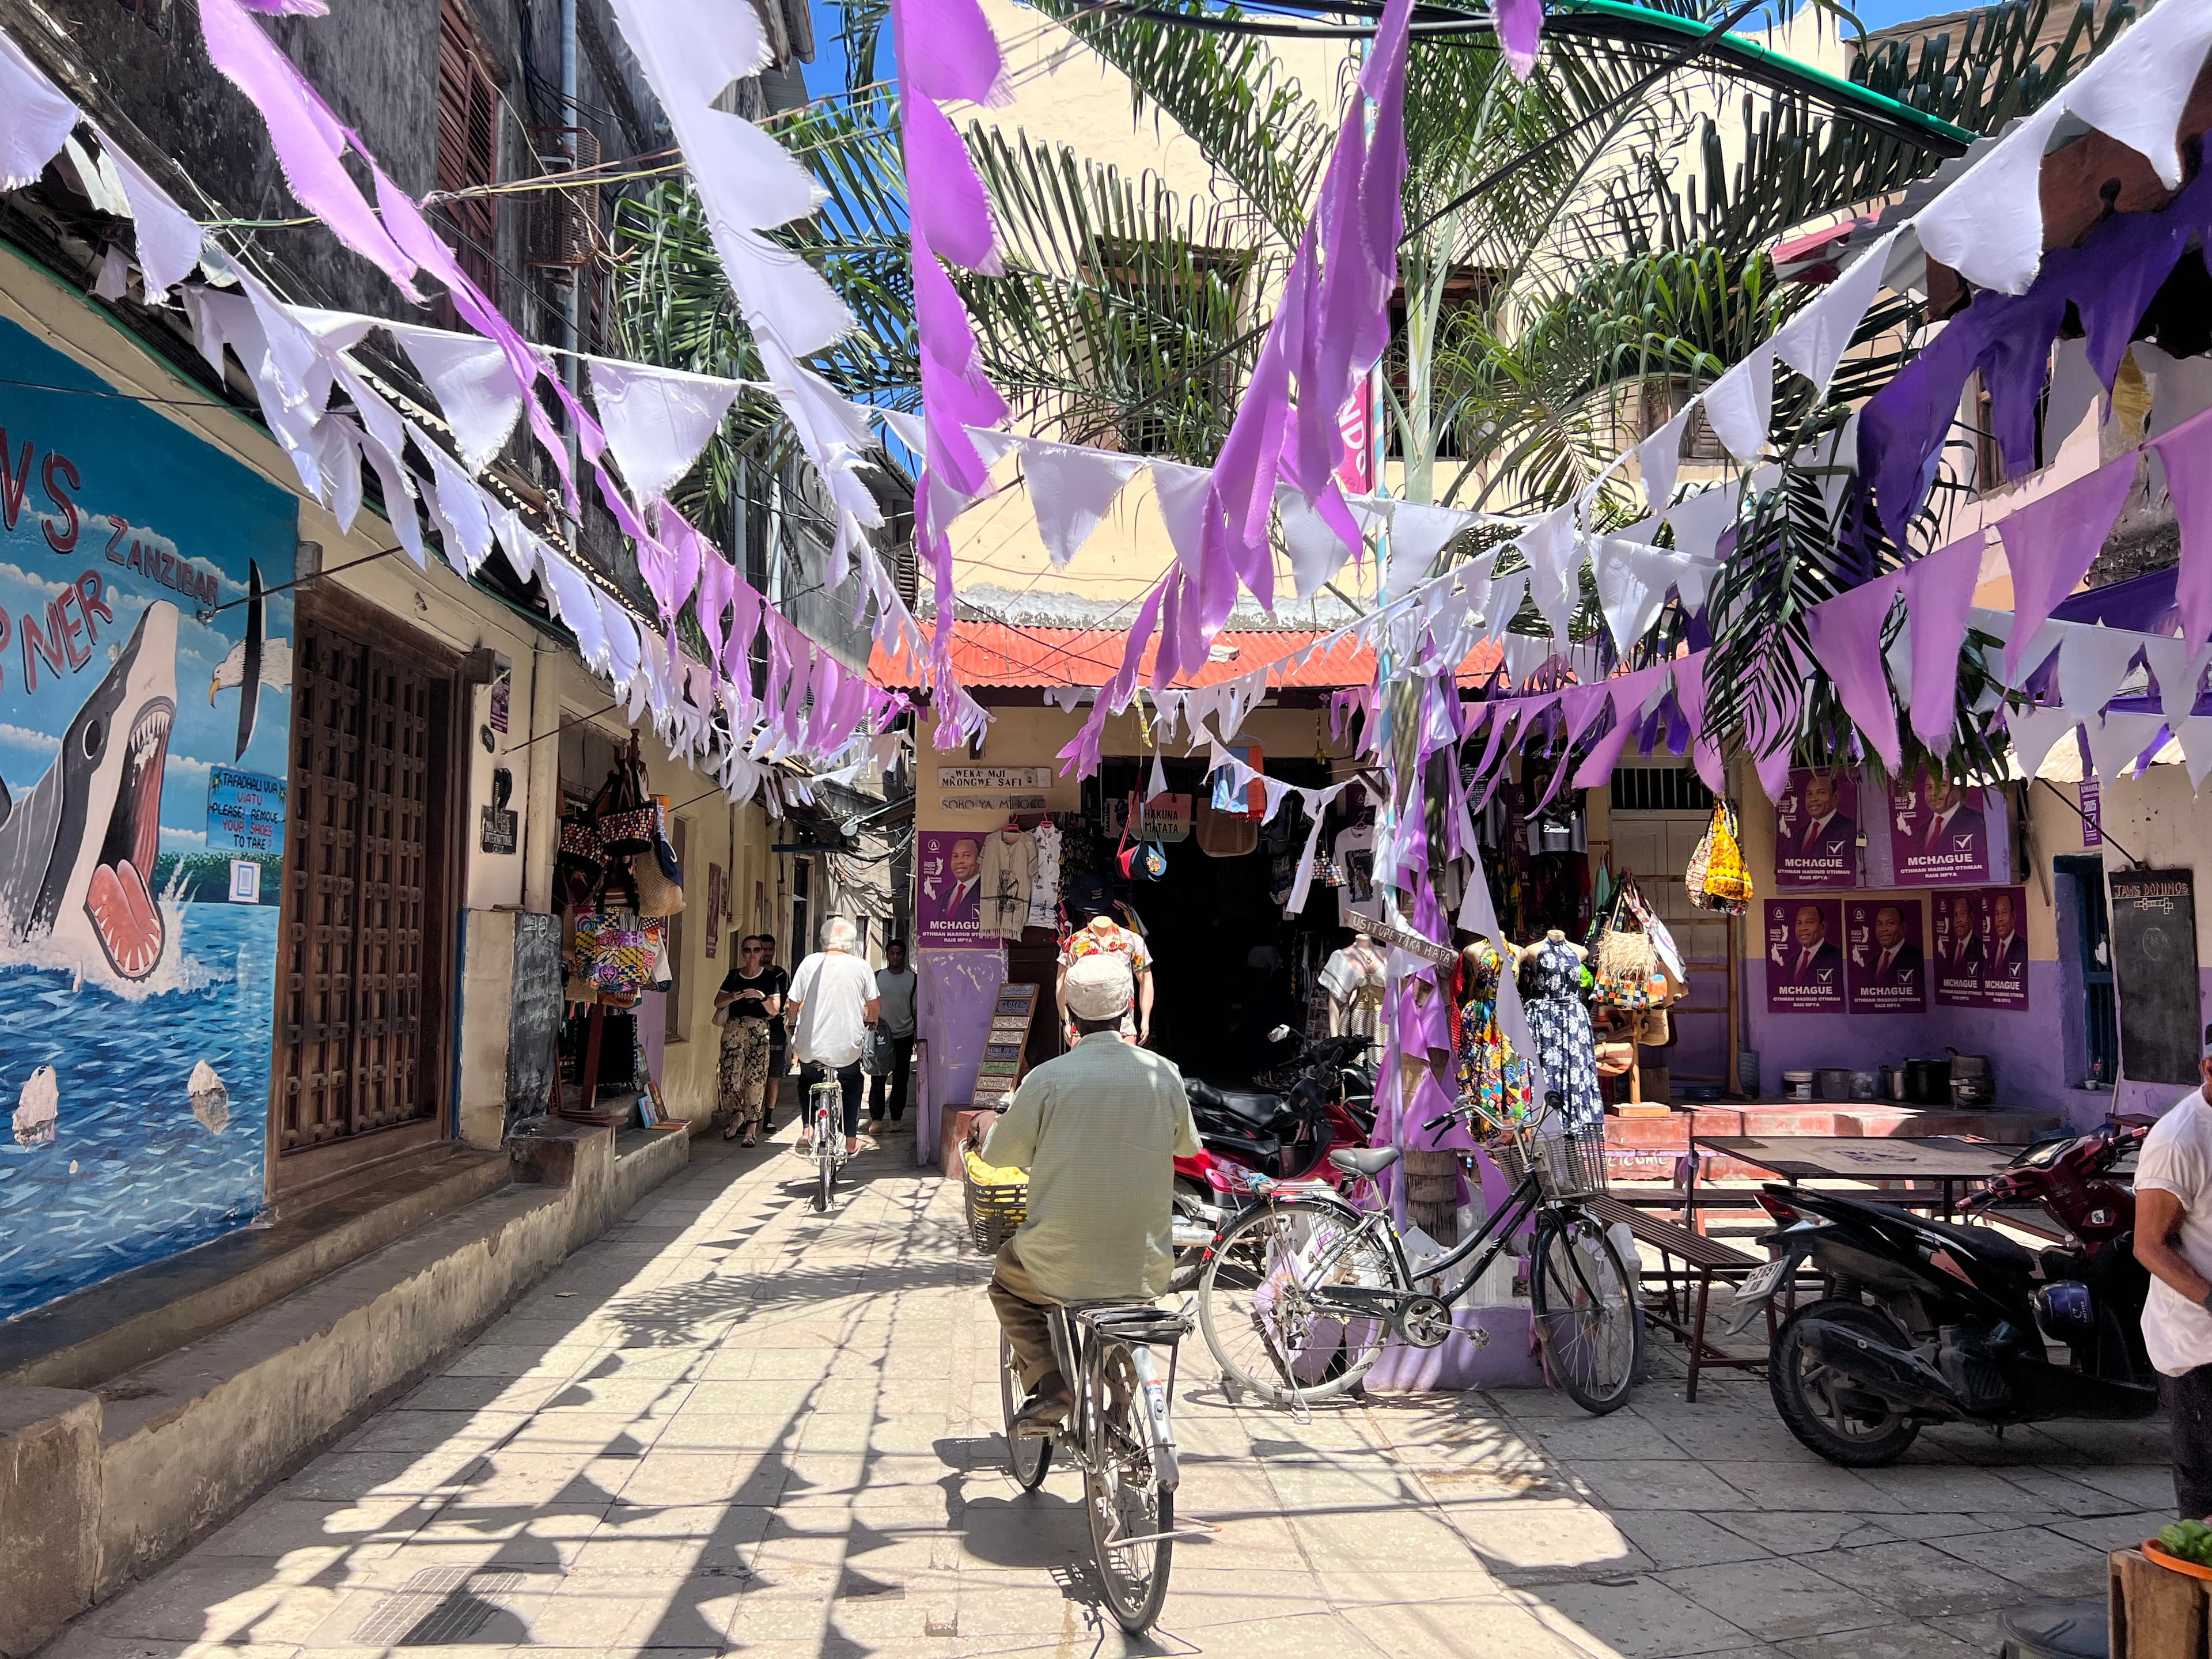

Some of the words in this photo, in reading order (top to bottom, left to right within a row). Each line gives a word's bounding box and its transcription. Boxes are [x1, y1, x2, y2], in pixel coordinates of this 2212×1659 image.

[105, 514, 219, 607] ZANZIBAR
[955, 770, 982, 778] WEKA
[988, 770, 1005, 778] MJI
[263, 780, 278, 794] VUA
[942, 778, 992, 787] MKONGWE
[998, 778, 1022, 787] SAFI
[237, 791, 263, 806] VIATU
[941, 799, 975, 810] SOKO
[979, 800, 993, 810] YA
[250, 808, 278, 824] REMOVE
[1144, 809, 1179, 821] HAKUNA
[222, 819, 245, 833] YOUR
[249, 822, 272, 838] SHOES
[1145, 821, 1179, 834] MATATA
[233, 834, 245, 848] TO
[247, 836, 266, 850] TAKE
[1785, 858, 1843, 868] MCHAGUE
[1907, 854, 1973, 866] MCHAGUE
[2113, 884, 2141, 897] JAWS
[930, 921, 980, 930] MCHAGU
[1353, 915, 1396, 941] USITUPE
[1397, 933, 1421, 952] TAKA
[1423, 944, 1450, 964] HAPA
[1944, 979, 1978, 988] MCHAGUE
[1984, 980, 2020, 990] MCHAGUE
[1779, 986, 1833, 995] MCHAGUE
[1860, 987, 1913, 995] MCHAGUE
